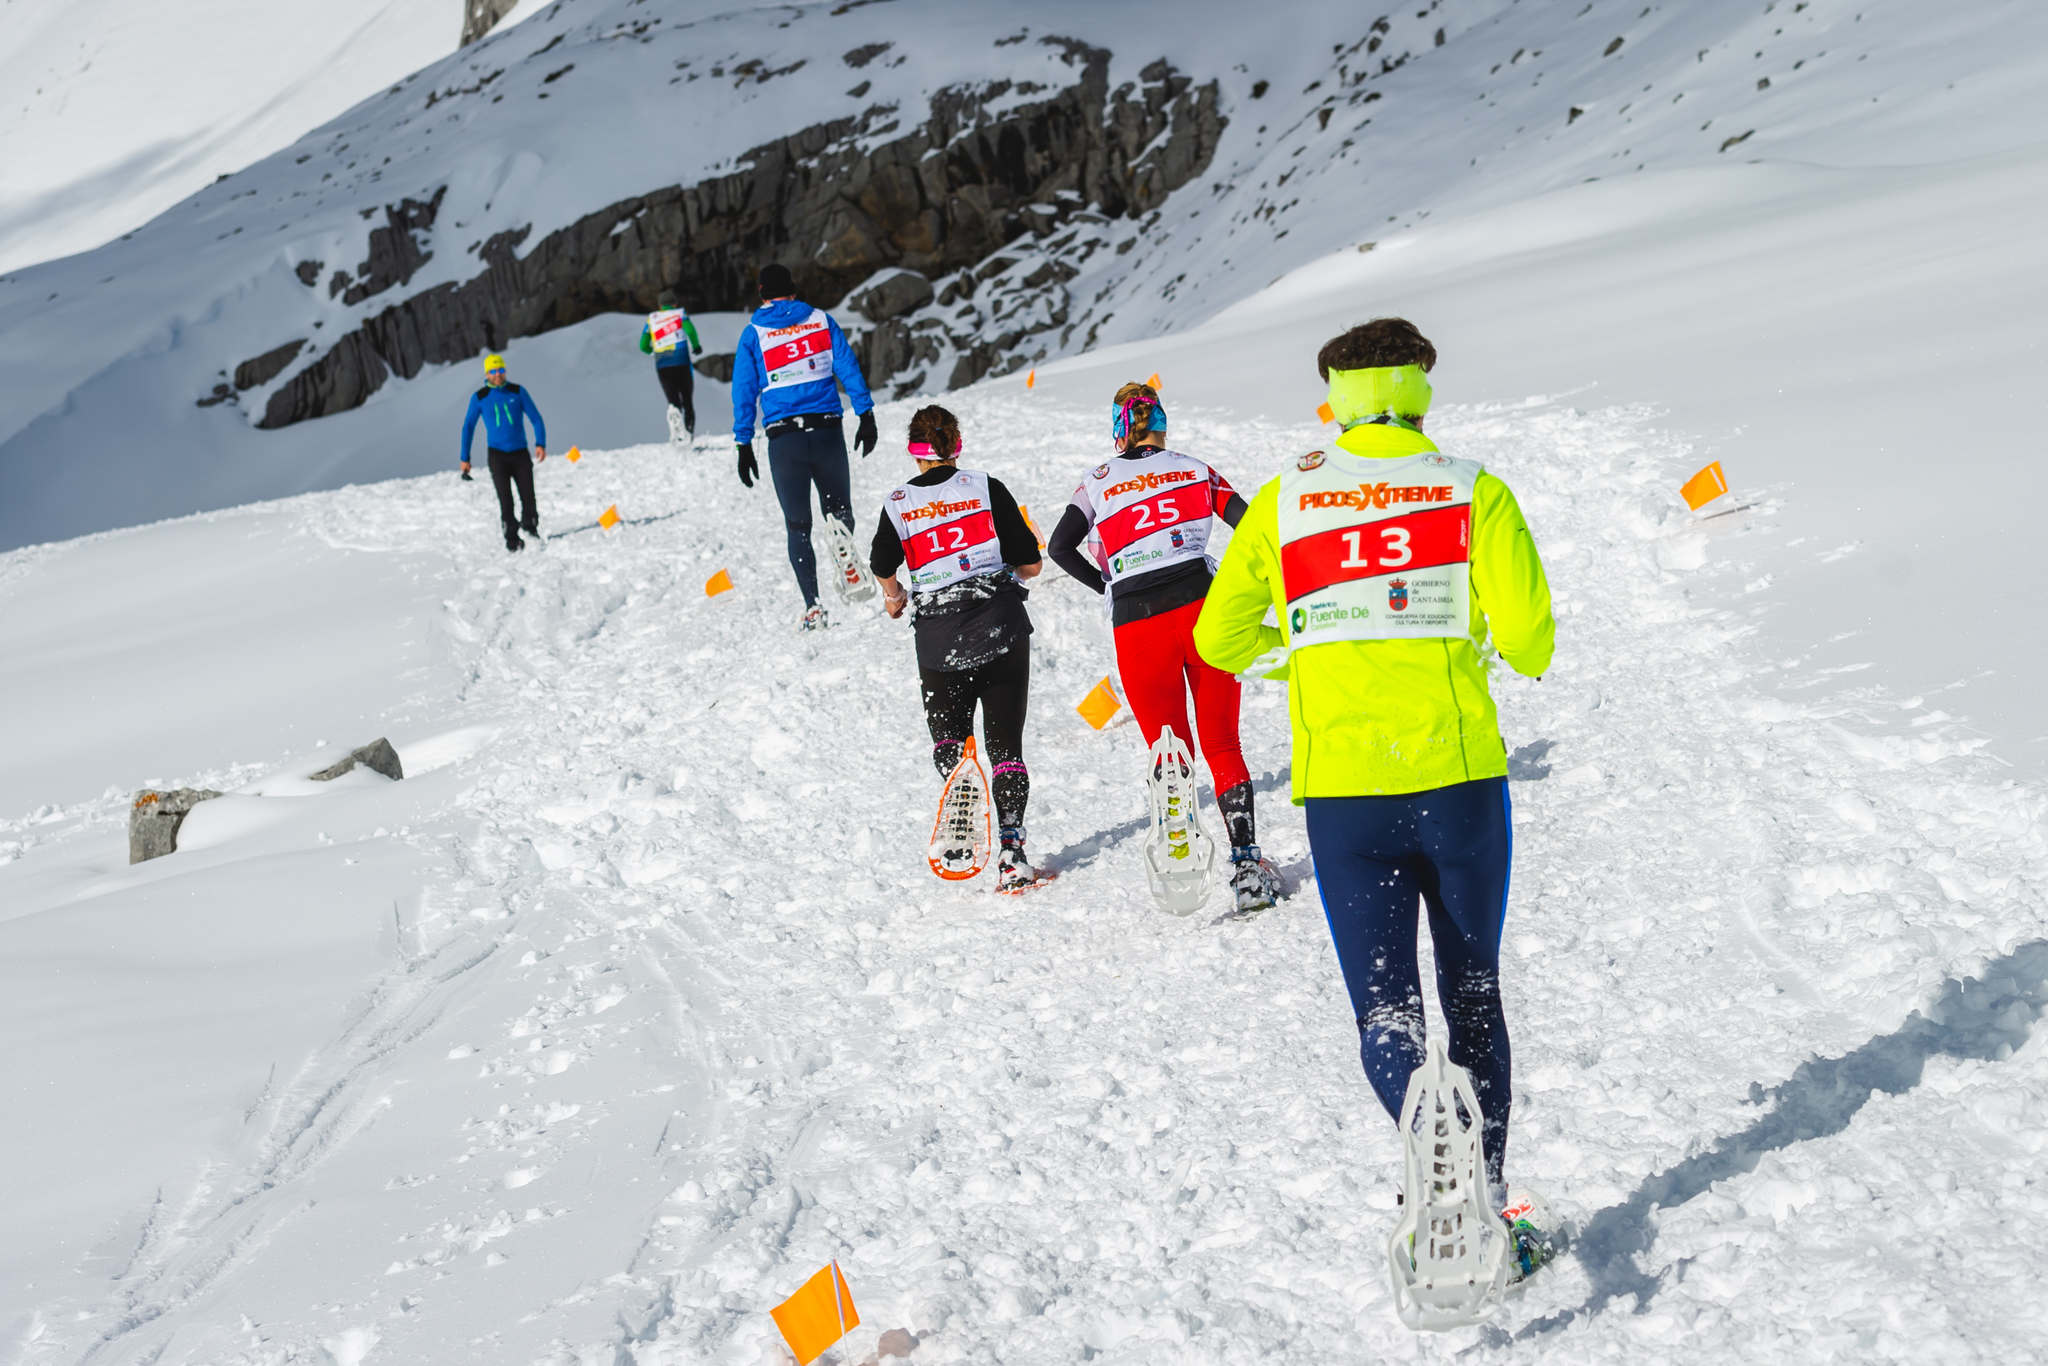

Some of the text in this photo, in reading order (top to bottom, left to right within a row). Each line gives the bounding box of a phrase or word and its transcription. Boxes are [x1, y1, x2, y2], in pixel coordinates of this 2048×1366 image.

[785, 339, 814, 359] 31
[1131, 498, 1180, 531] 25
[926, 527, 969, 553] 12
[1340, 527, 1413, 569] 13
[1411, 580, 1451, 588] GOBIERNO
[1310, 606, 1369, 624] Fuente Dé
